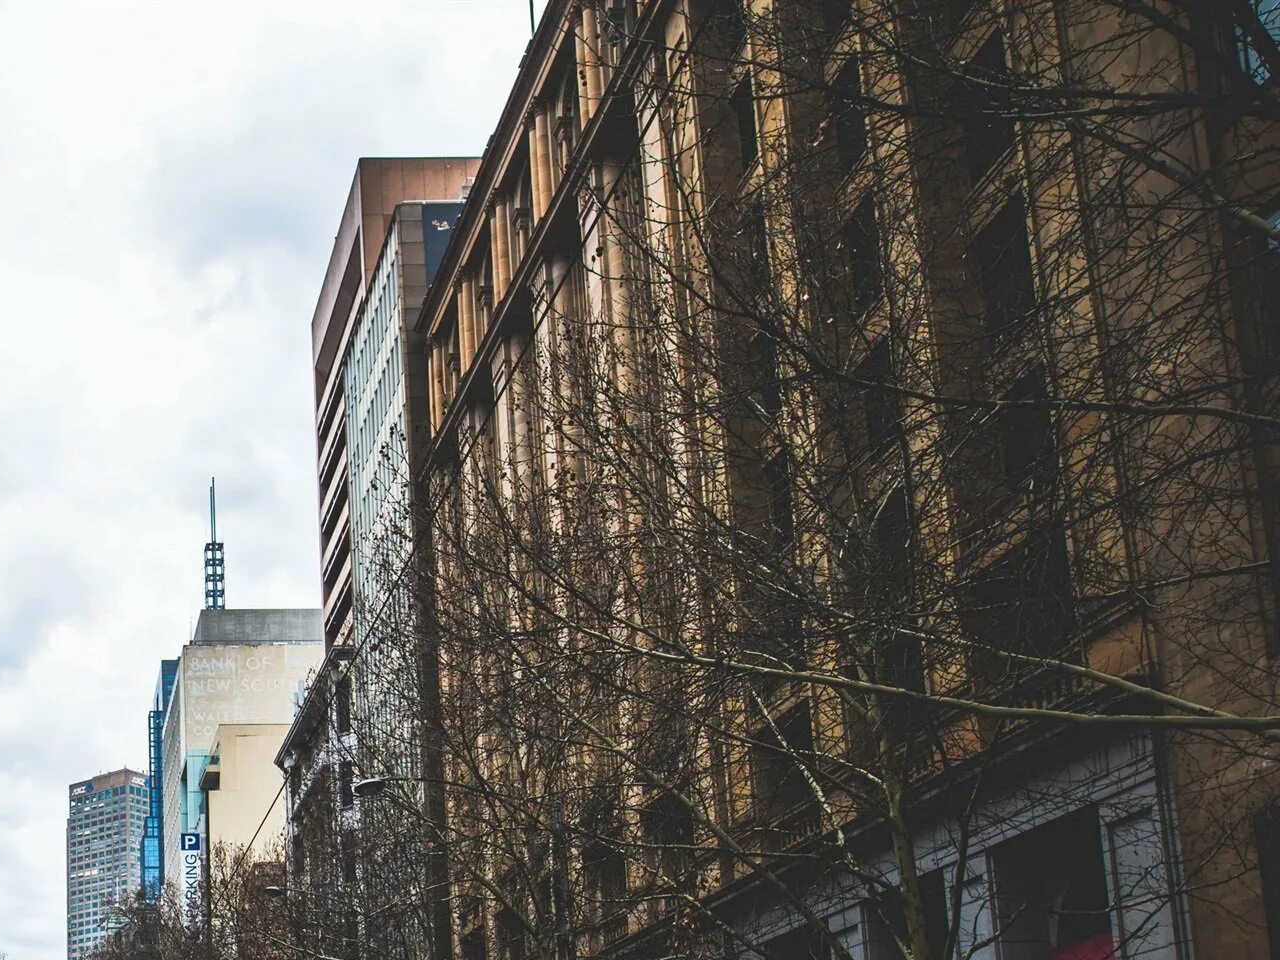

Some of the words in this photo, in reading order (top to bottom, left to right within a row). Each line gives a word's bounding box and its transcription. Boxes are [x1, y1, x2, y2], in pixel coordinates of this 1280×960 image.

[191, 657, 236, 671] BANK
[246, 656, 273, 671] OF
[191, 678, 231, 693] NEW
[192, 711, 240, 722] WALES
[184, 835, 196, 850] P
